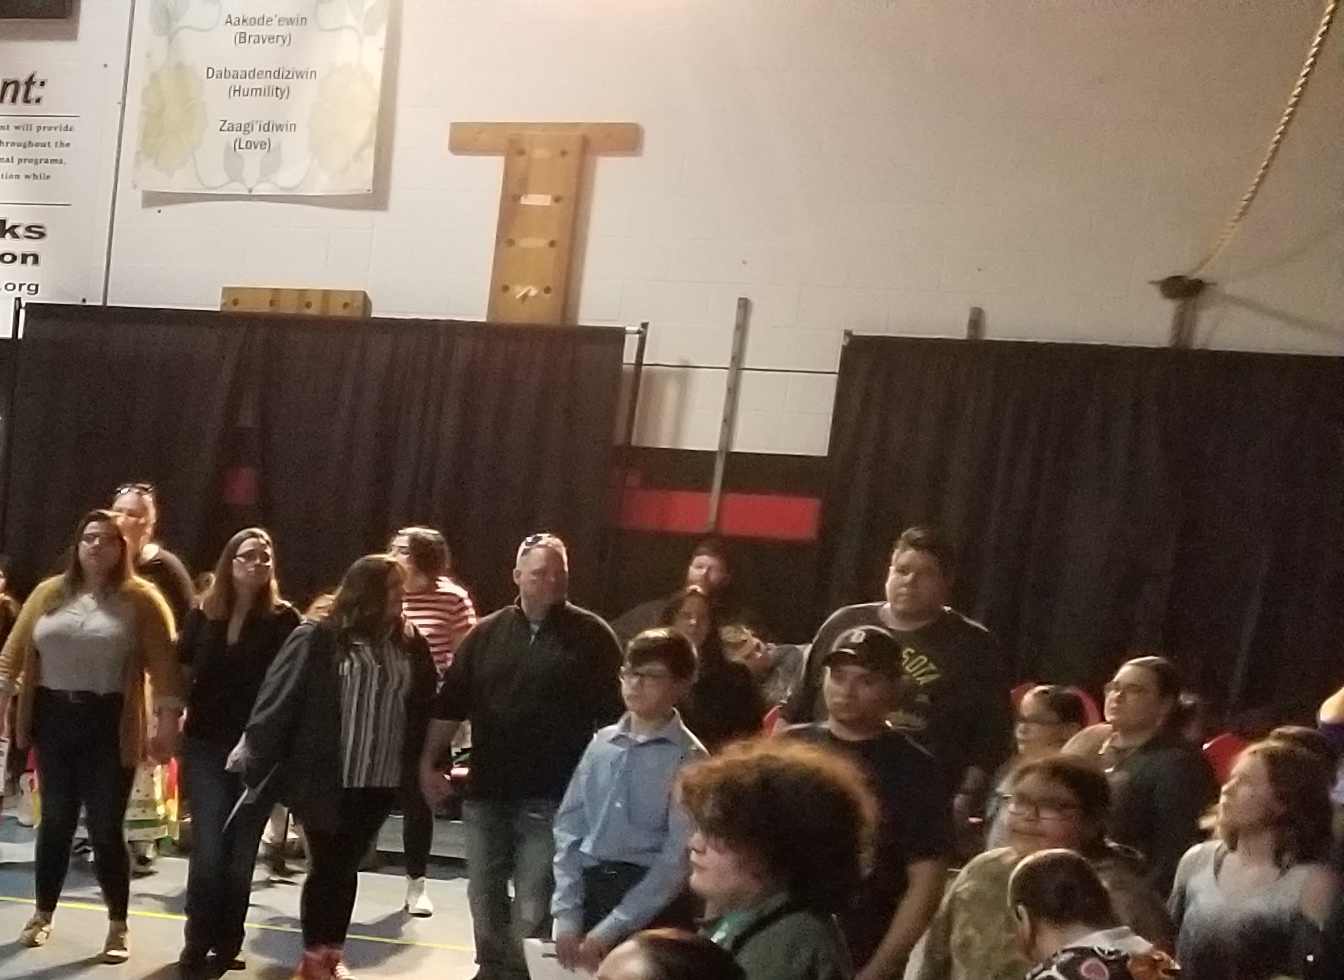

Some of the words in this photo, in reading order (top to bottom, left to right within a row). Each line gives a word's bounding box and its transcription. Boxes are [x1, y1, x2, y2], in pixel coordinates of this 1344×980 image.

[225, 14, 308, 27] Aakode'ewin
[234, 31, 292, 46] (Bravery)
[206, 66, 317, 80] Dabaadendiziwin
[228, 84, 290, 100] (Humility)
[14, 124, 33, 132] will
[36, 124, 74, 133] provide
[55, 140, 71, 148] the
[233, 138, 271, 152] (Love)
[17, 156, 66, 165] programs,
